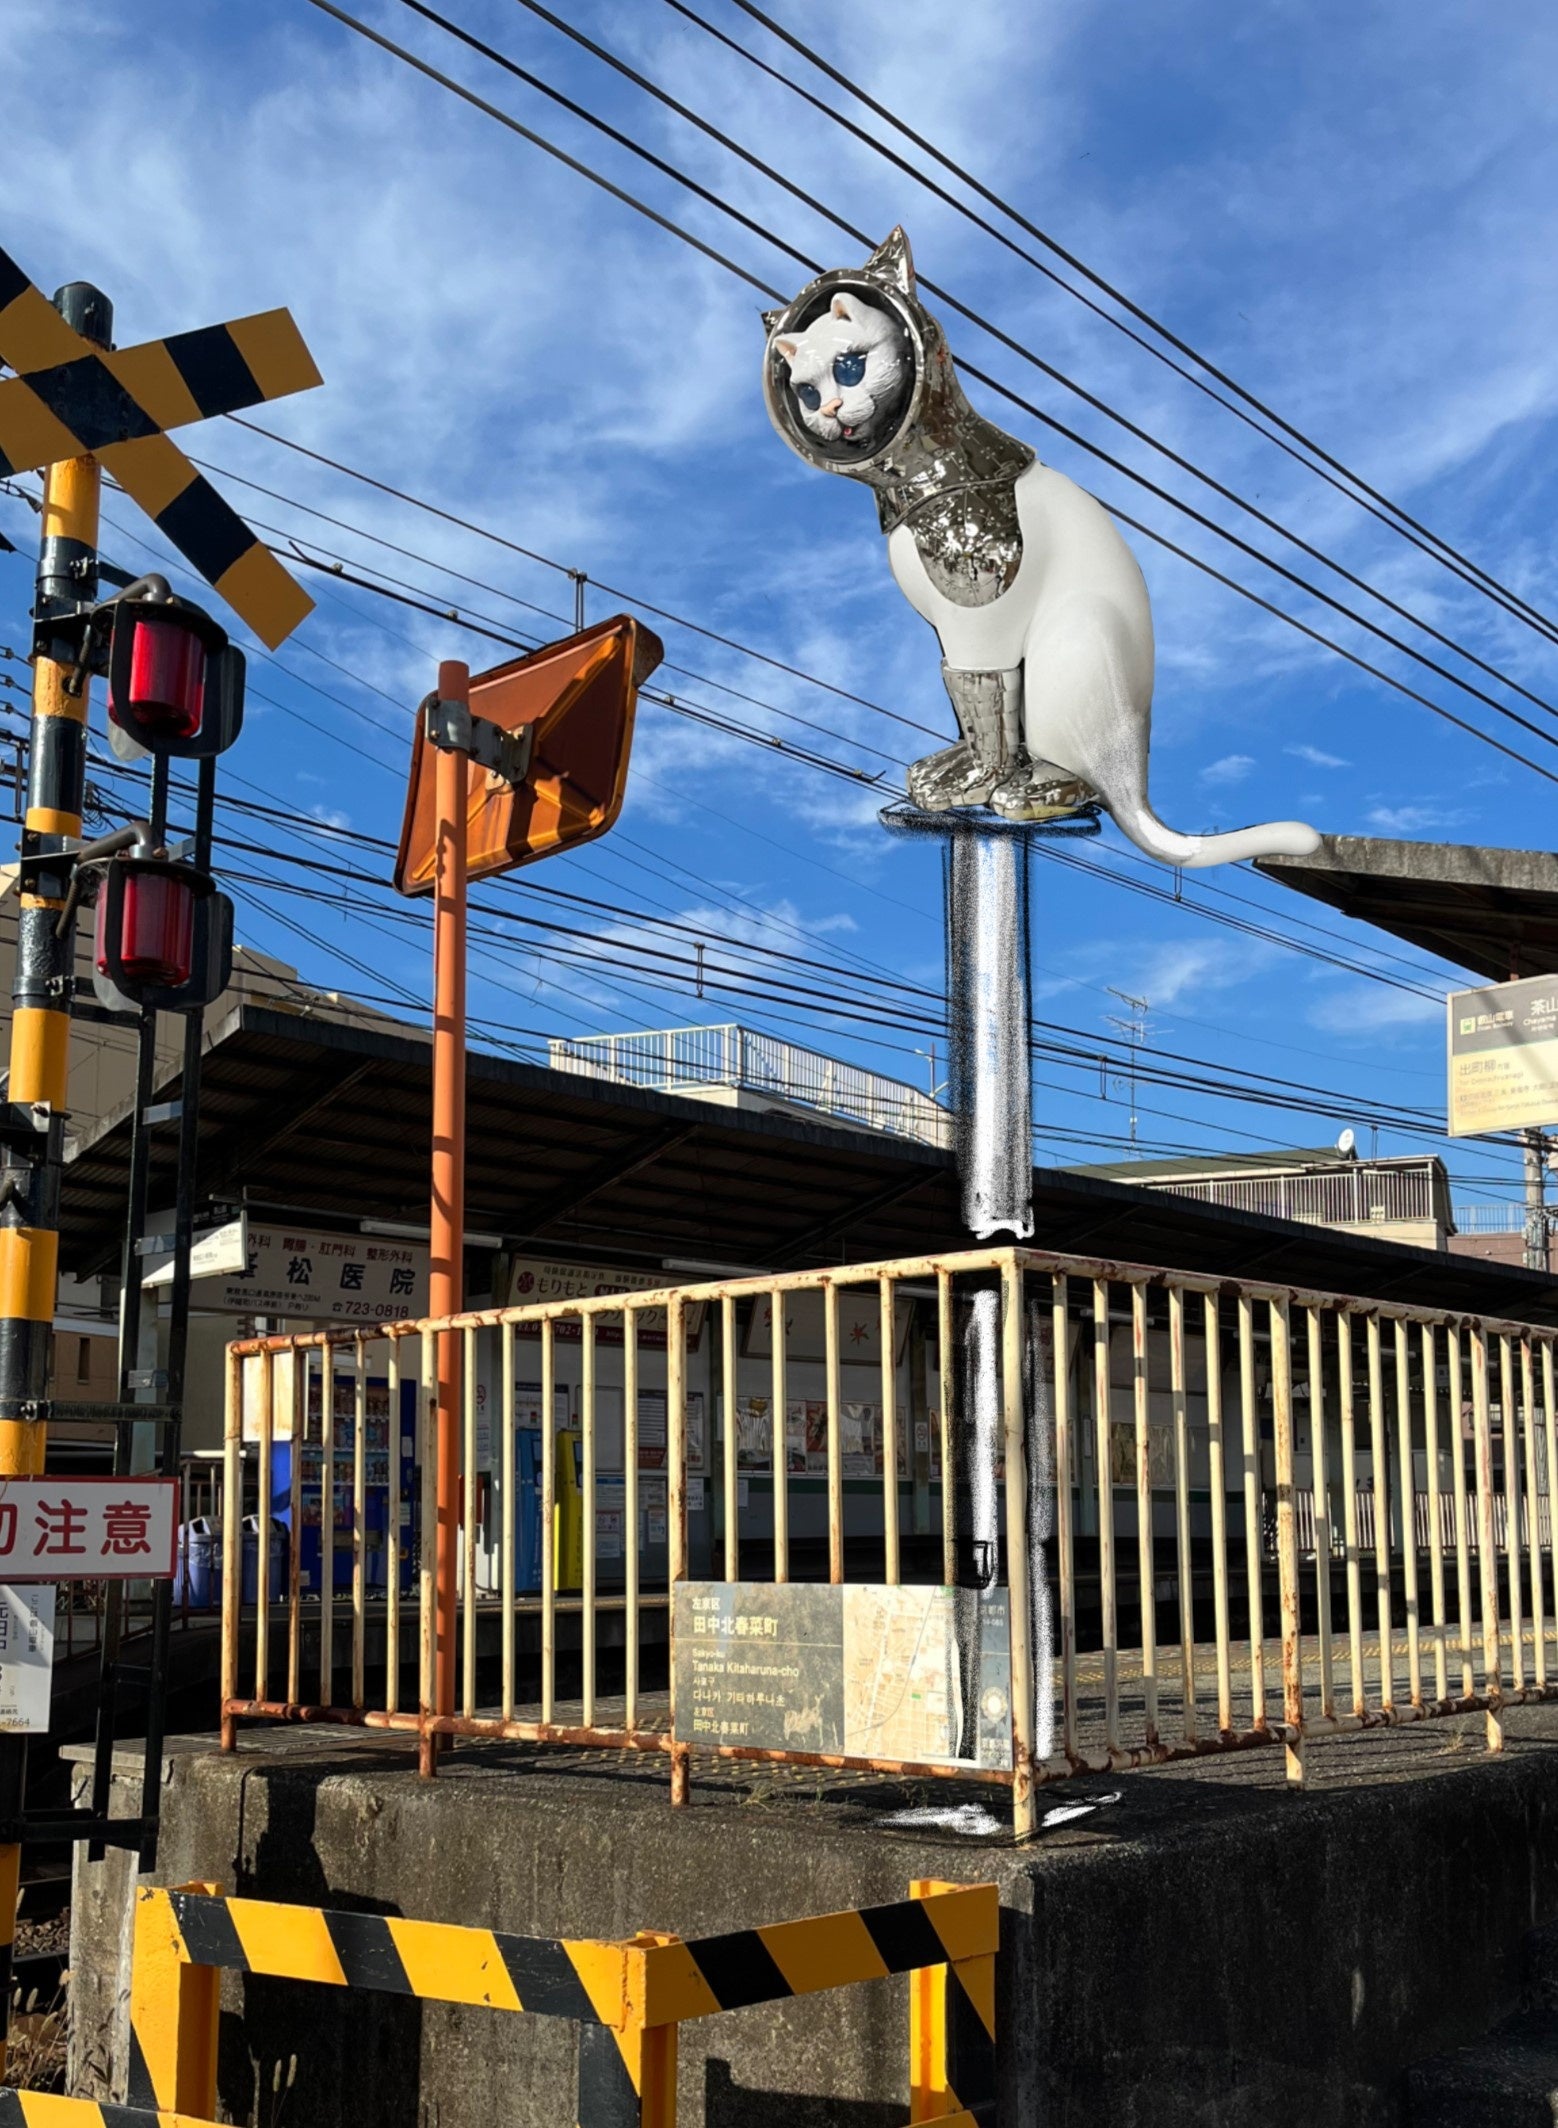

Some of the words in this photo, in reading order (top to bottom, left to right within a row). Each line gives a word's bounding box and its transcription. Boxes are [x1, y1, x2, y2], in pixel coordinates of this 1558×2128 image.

[537, 1277, 588, 1298] もりもと
[344, 1301, 409, 1318] 723-0818
[692, 1597, 720, 1610] 左京区
[693, 1615, 779, 1637] 田中北春菜町
[692, 1660, 725, 1673] Tanaka
[727, 1661, 800, 1677] Kitaharuna-cho
[693, 1689, 722, 1703] 다나카
